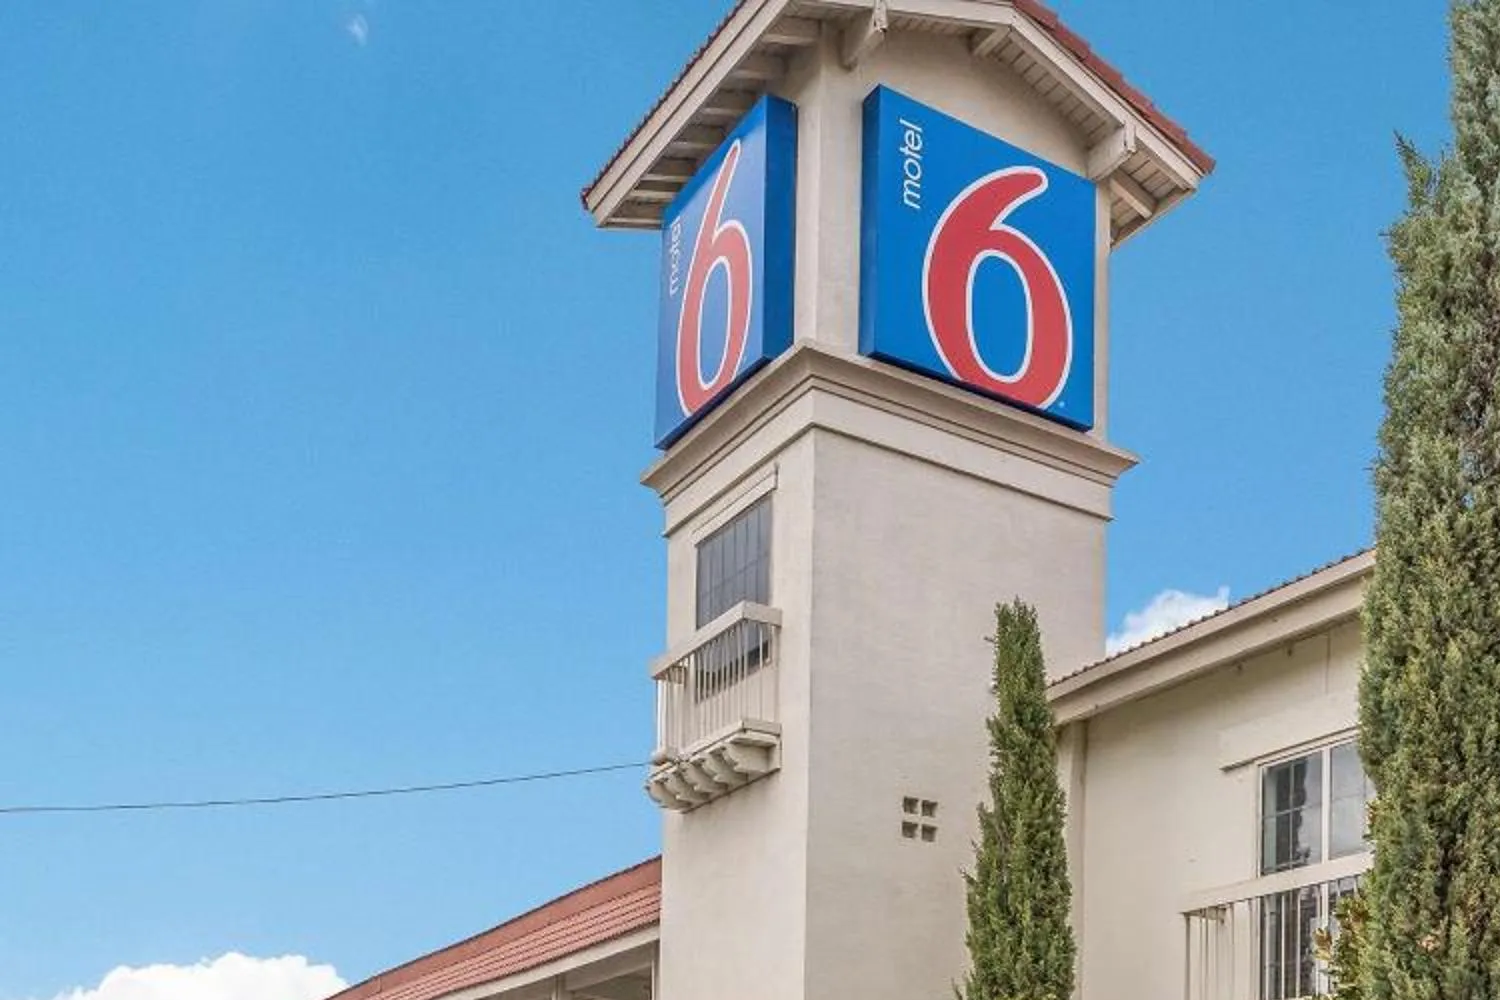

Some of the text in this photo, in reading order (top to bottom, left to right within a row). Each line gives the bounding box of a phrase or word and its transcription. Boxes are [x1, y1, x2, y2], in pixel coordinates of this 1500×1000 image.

[675, 138, 753, 419] 6
[899, 117, 923, 209] motel
[922, 165, 1074, 411] 6
